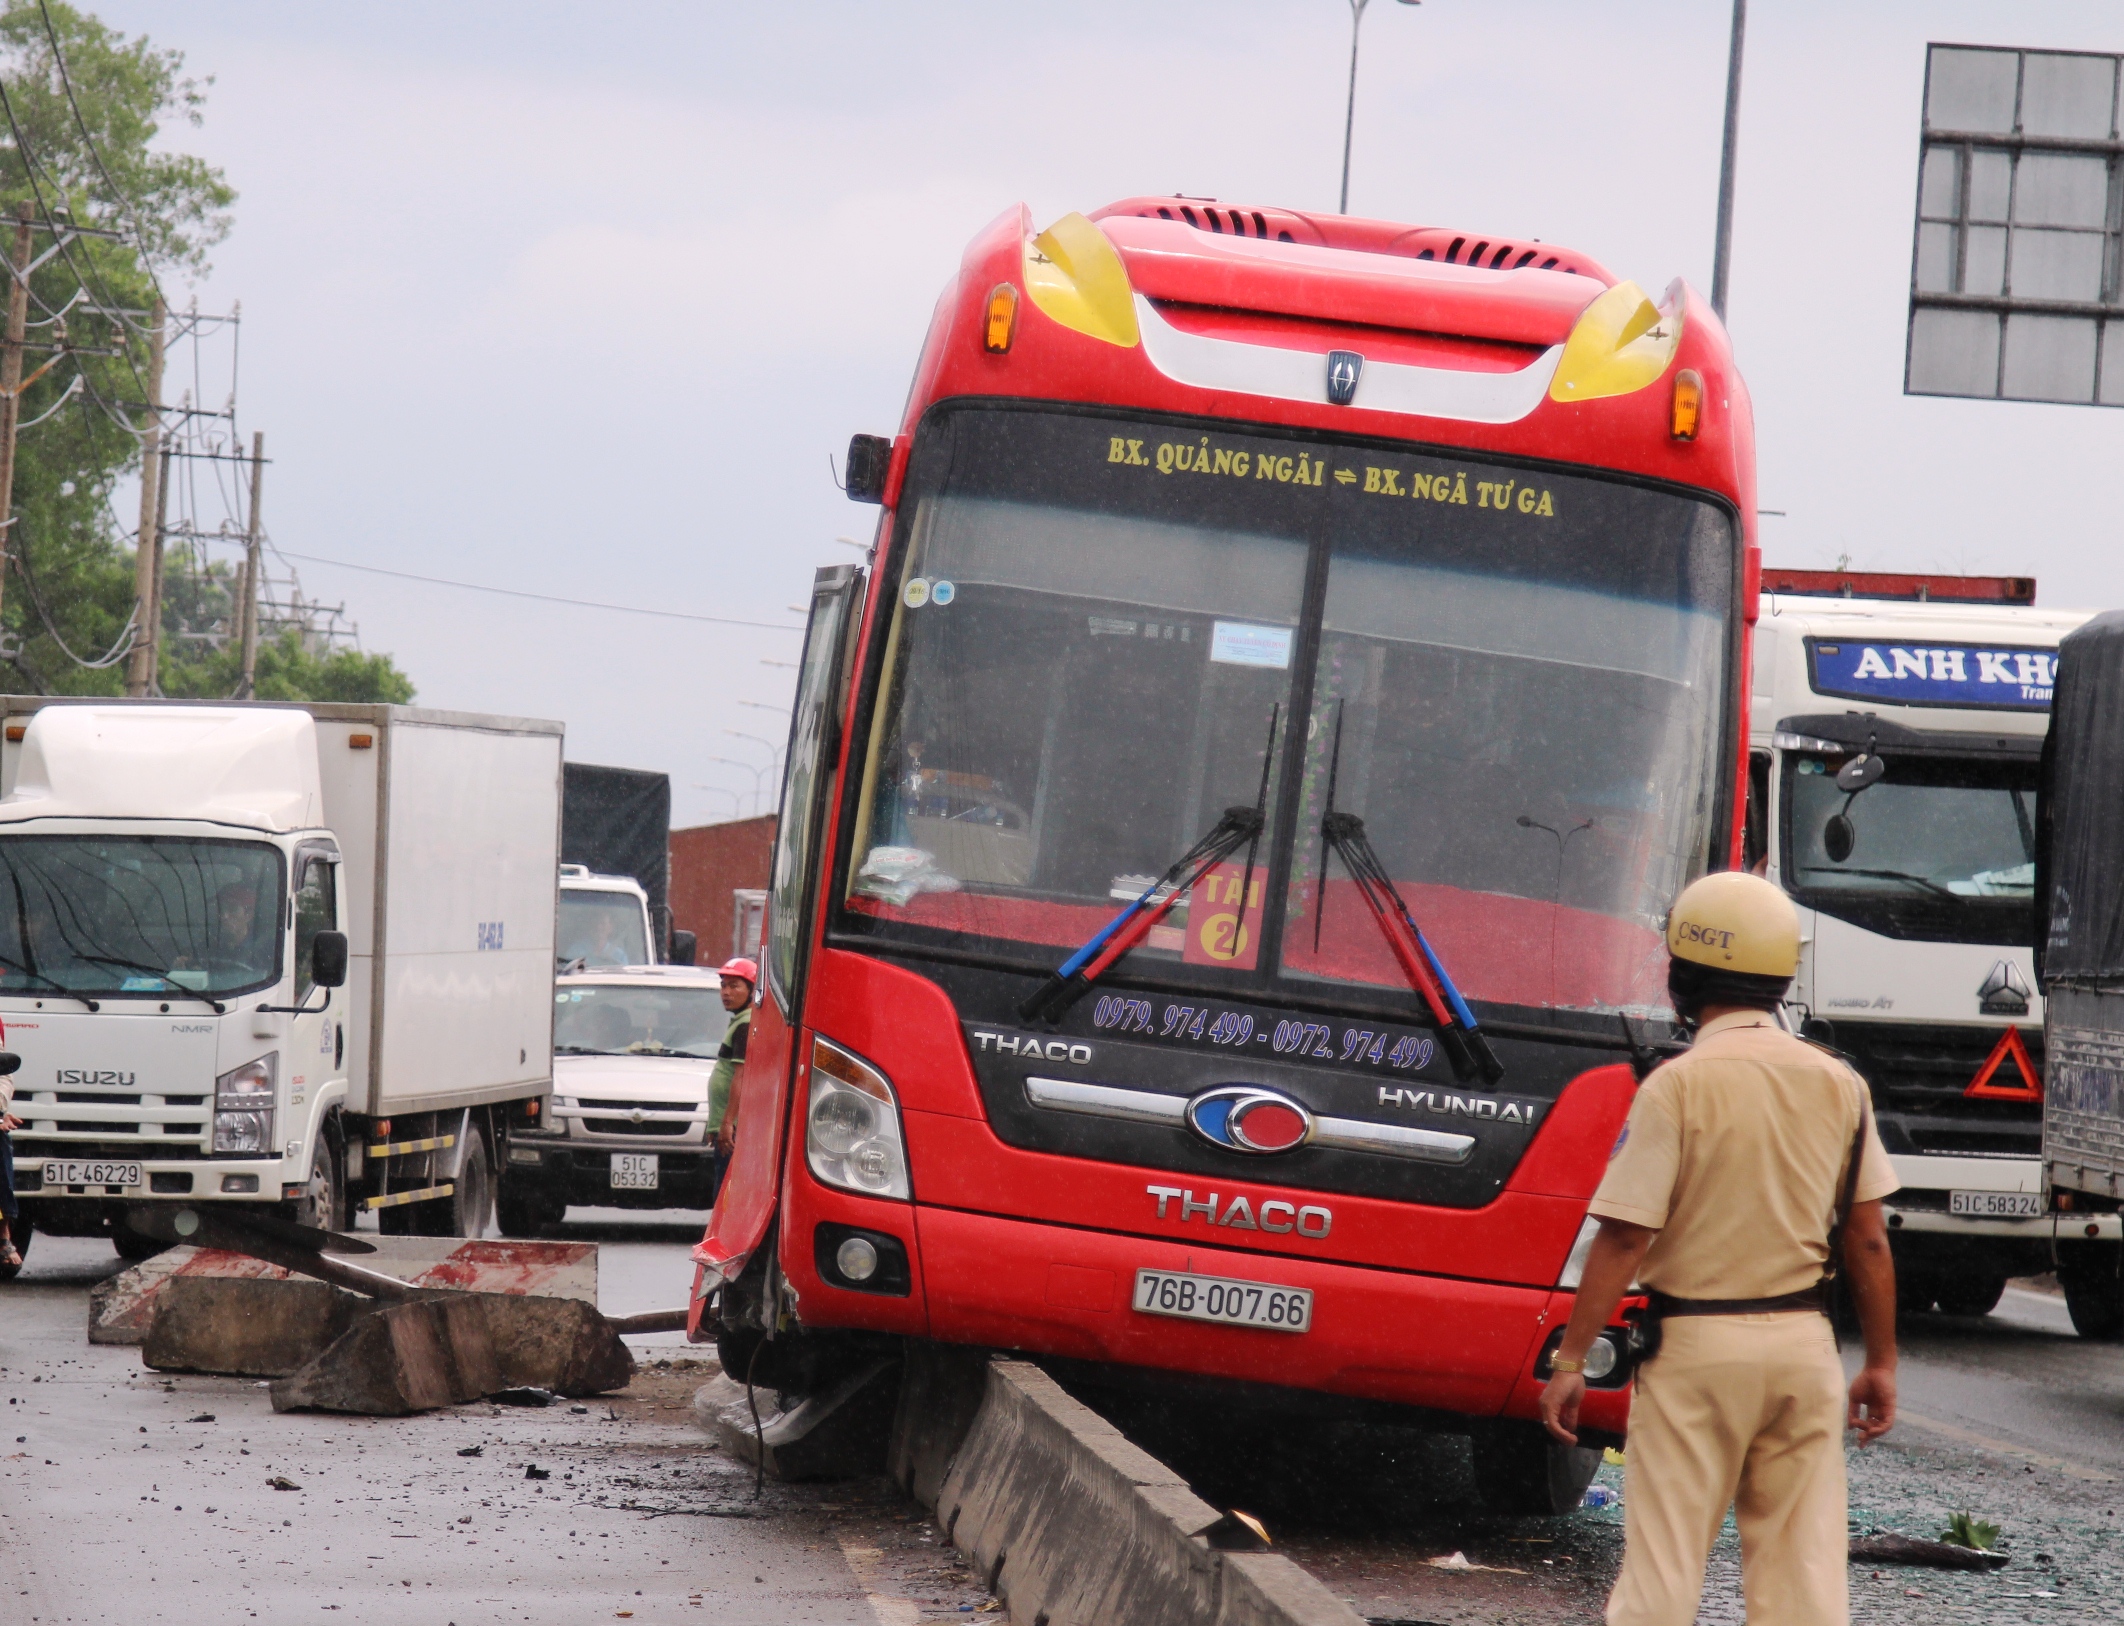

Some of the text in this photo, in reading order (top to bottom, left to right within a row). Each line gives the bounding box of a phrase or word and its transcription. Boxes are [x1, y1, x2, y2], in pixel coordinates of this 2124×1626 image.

[1107, 436, 1554, 517] BX. QUẢNG NGÃI BX. NGÃ TƯ GA
[1854, 647, 1967, 682] ANH
[1205, 871, 1260, 908] TÀI
[1213, 920, 1236, 953] 2
[1679, 921, 1735, 949] CSGT
[171, 1025, 212, 1033] NMR
[1094, 996, 1153, 1034] 0979.
[1160, 1005, 1208, 1040] 974
[1208, 1011, 1254, 1046] 499
[1273, 1019, 1333, 1059] 0972.
[1340, 1028, 1387, 1064] 974
[1388, 1036, 1434, 1070] 499
[974, 1031, 1092, 1065] THACO
[57, 1070, 135, 1086] ISUZU
[1378, 1086, 1534, 1125] HYUNDAI
[46, 1163, 138, 1183] 51C-462.29
[622, 1156, 646, 1171] 51C
[1146, 1185, 1332, 1239] THACO
[1143, 1275, 1305, 1326] 76B-007.66
